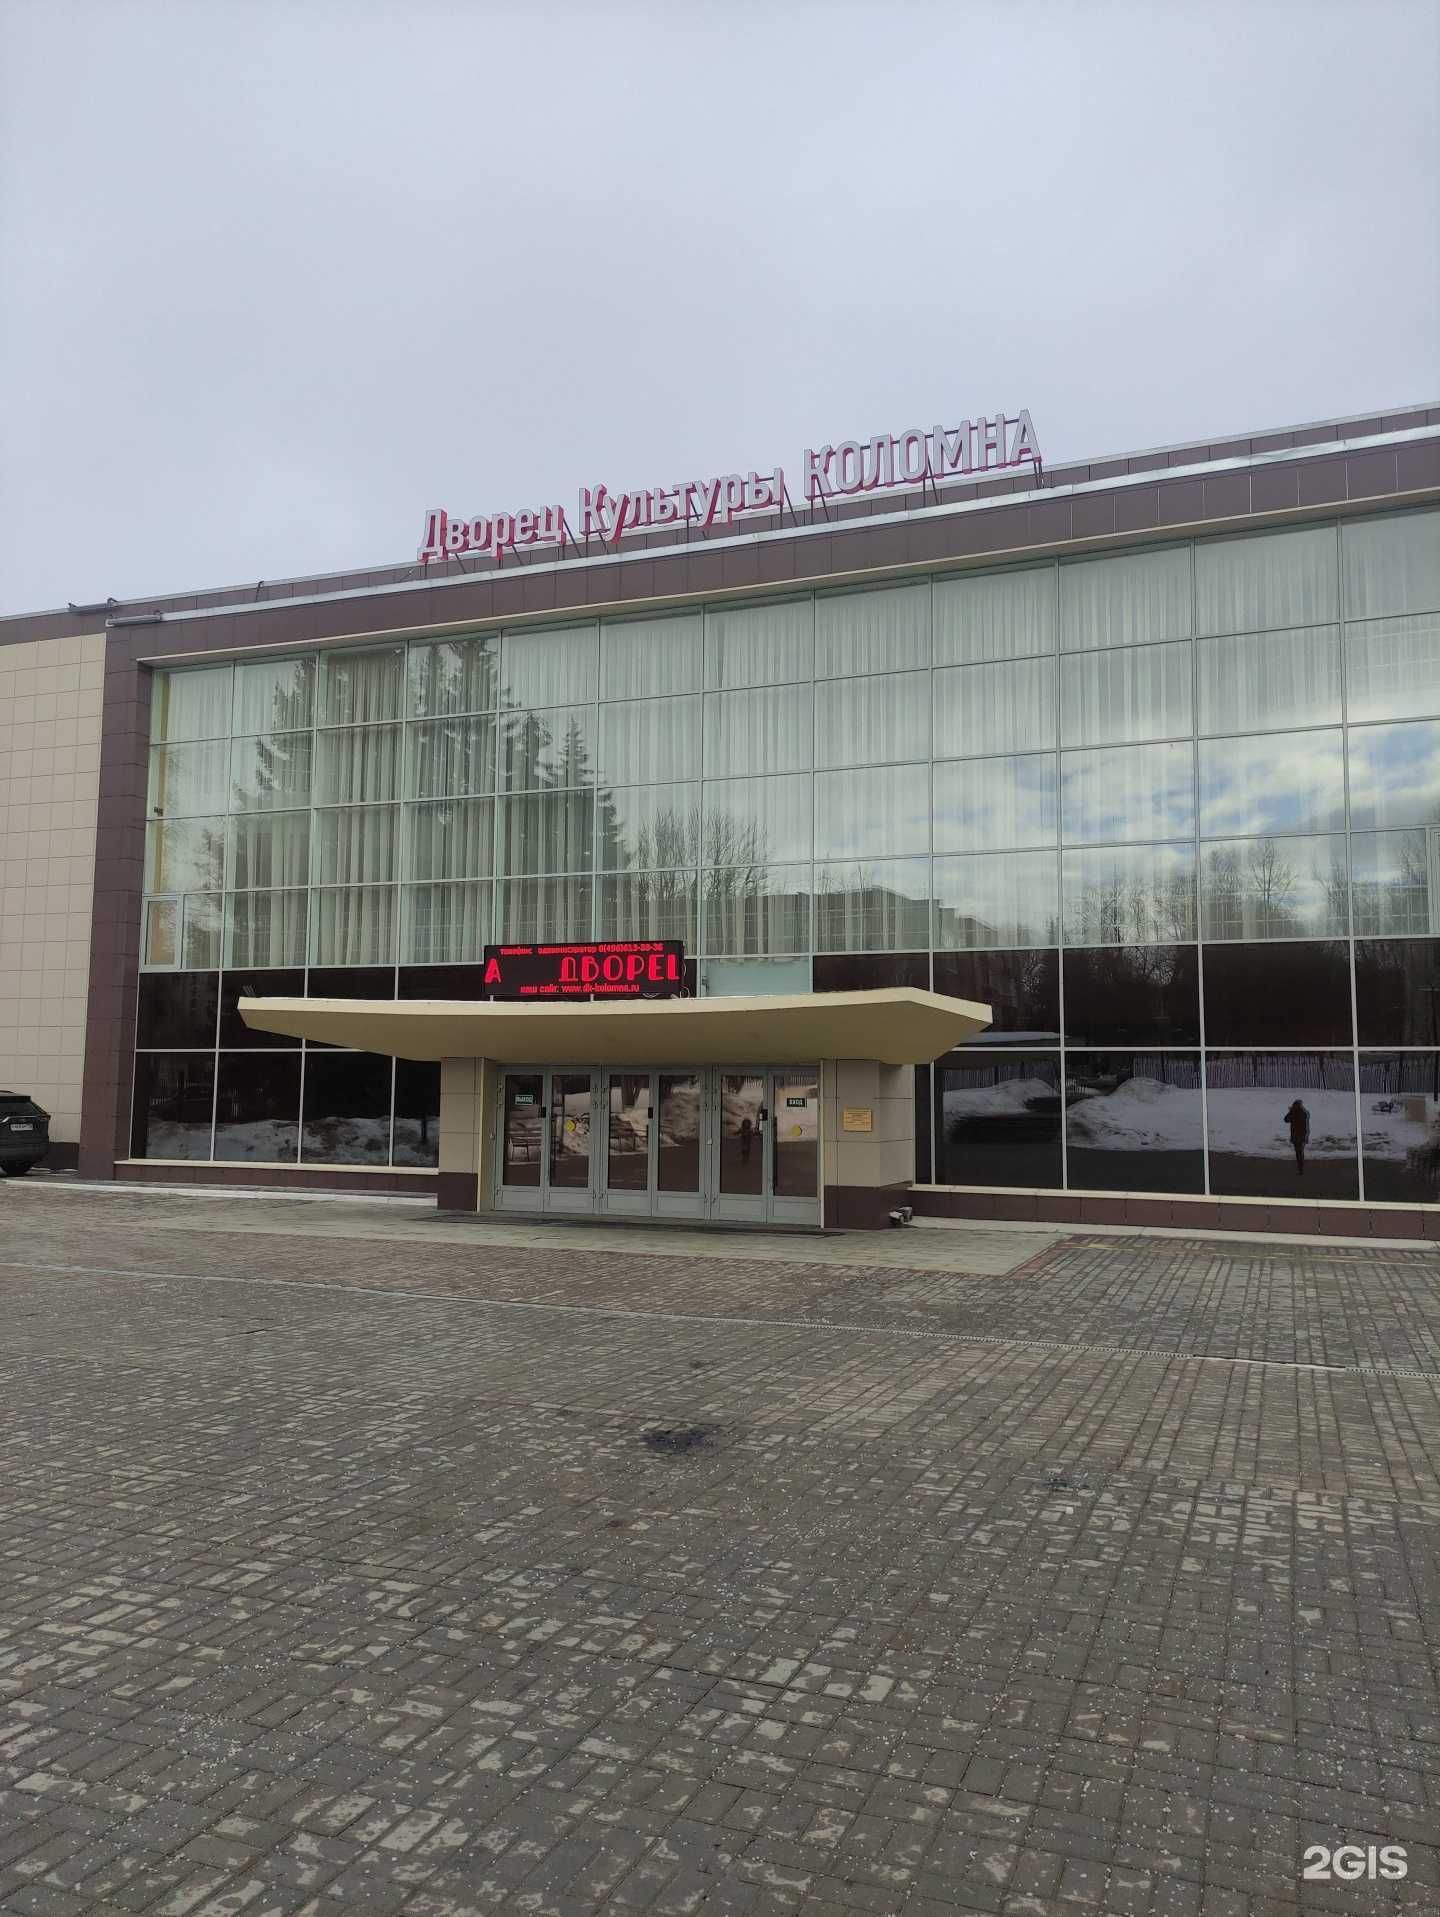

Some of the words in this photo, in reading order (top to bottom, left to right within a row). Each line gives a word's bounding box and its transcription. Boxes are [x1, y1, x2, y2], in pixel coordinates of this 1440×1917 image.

[417, 505, 566, 563] Дворец
[579, 467, 784, 543] Культуры
[804, 408, 1042, 499] КОЛОМНА
